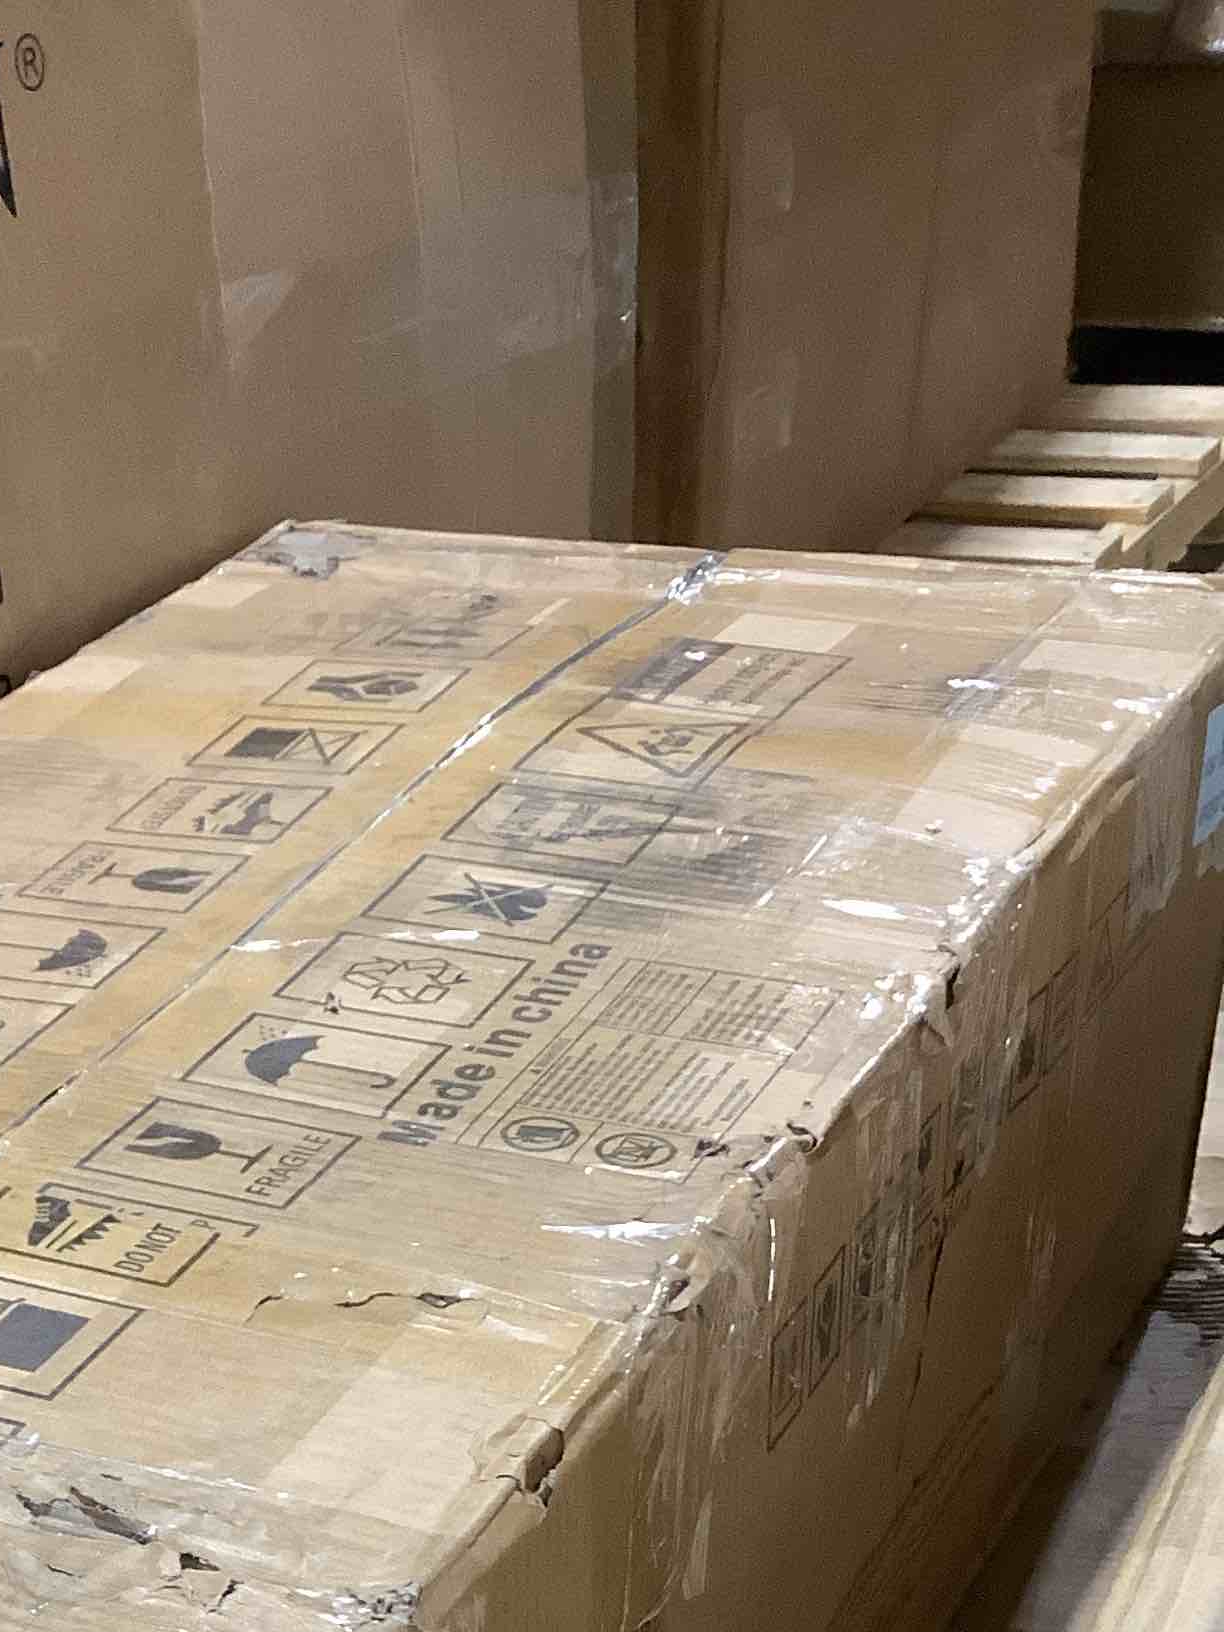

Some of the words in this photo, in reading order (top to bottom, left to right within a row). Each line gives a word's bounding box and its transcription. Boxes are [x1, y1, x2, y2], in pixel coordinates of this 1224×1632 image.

[376, 1063, 496, 1147] Made
[461, 1028, 533, 1058] in
[511, 943, 613, 1024] china
[244, 1133, 332, 1197] FRAGILE
